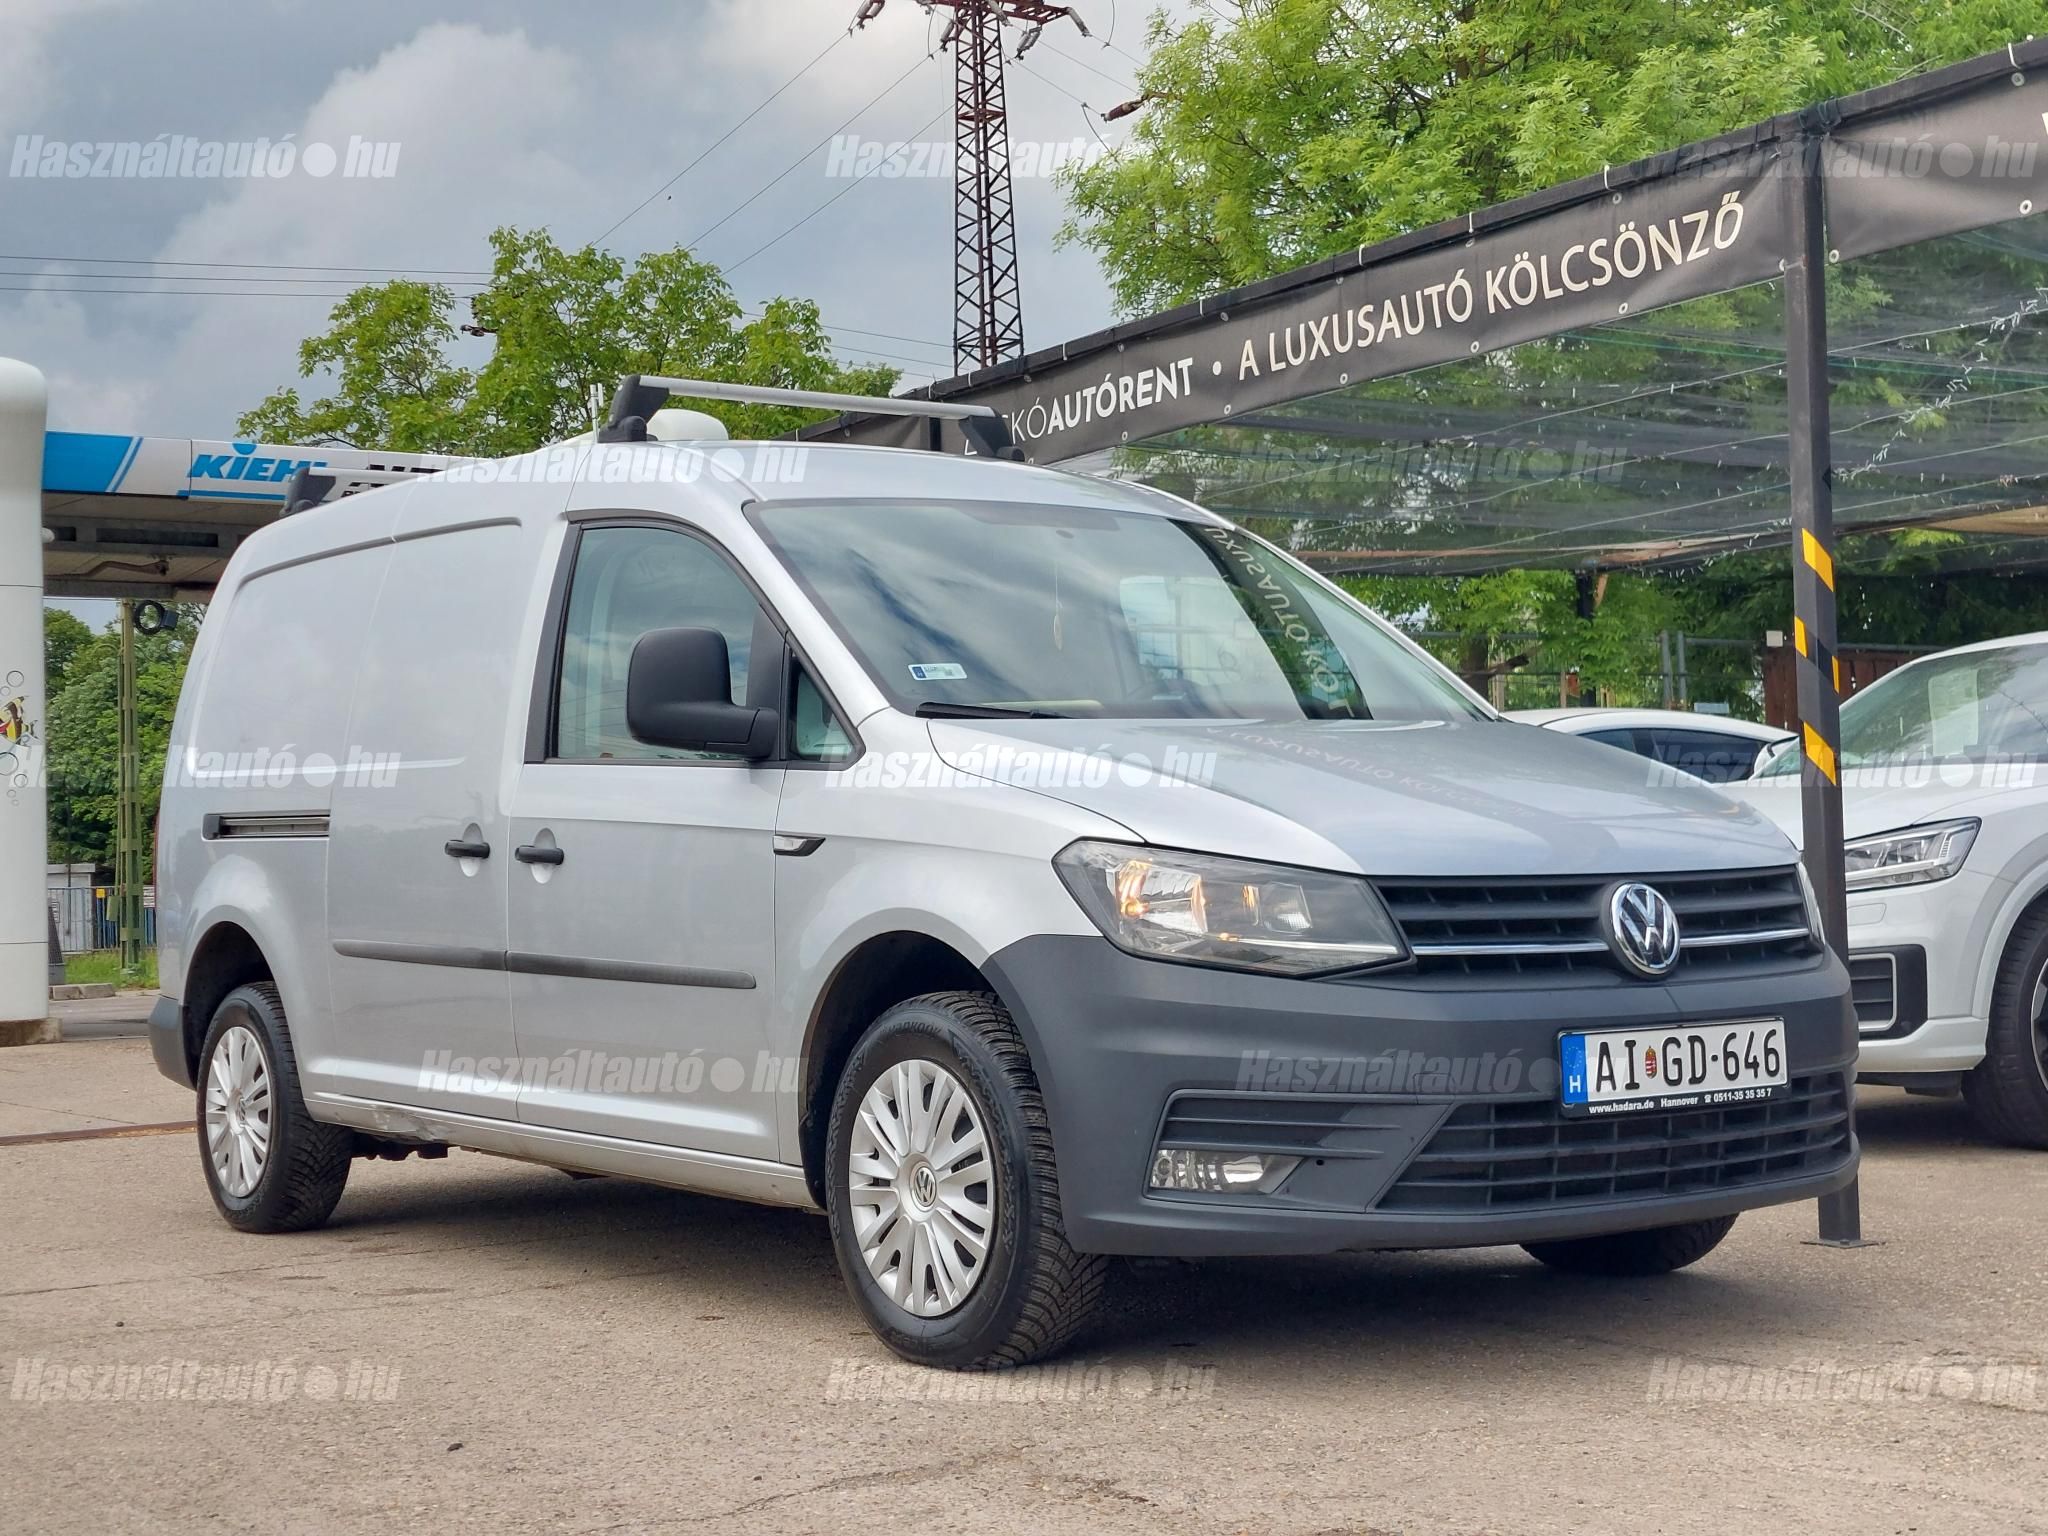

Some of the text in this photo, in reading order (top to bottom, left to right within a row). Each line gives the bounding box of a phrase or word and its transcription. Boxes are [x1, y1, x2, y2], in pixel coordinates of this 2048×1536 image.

[1238, 338, 1260, 381] A
[1267, 267, 1474, 372] LUXUSAUTÓ
[1484, 190, 1745, 315] KÖLCSÖNZŐ
[187, 443, 327, 482] KIEH
[1568, 1028, 1781, 1094] H AI GD-646
[1588, 1100, 1655, 1115] www.hadara.de
[1660, 1096, 1699, 1109] Hannover
